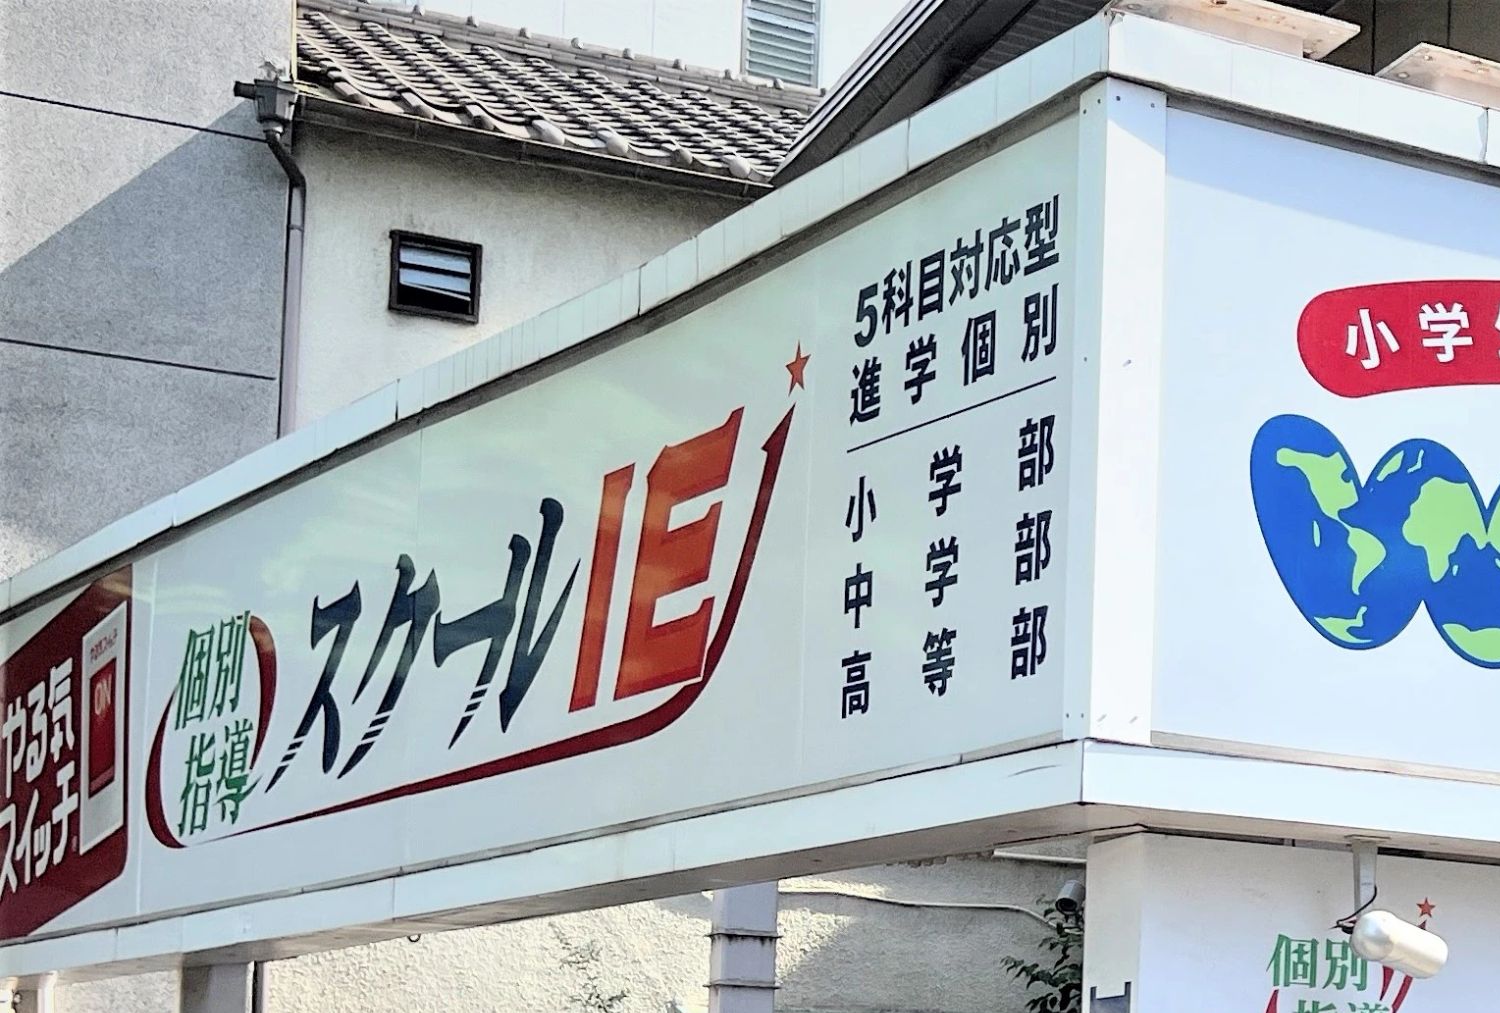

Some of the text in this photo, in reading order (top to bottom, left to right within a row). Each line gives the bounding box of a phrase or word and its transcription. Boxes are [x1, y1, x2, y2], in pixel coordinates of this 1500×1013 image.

[852, 192, 1061, 348] 5科目対応型
[848, 282, 1059, 426] 進学個別
[2, 657, 75, 799] やる気
[174, 609, 254, 727] 個別
[0, 759, 79, 895] スイッチ
[177, 718, 262, 838] 指導
